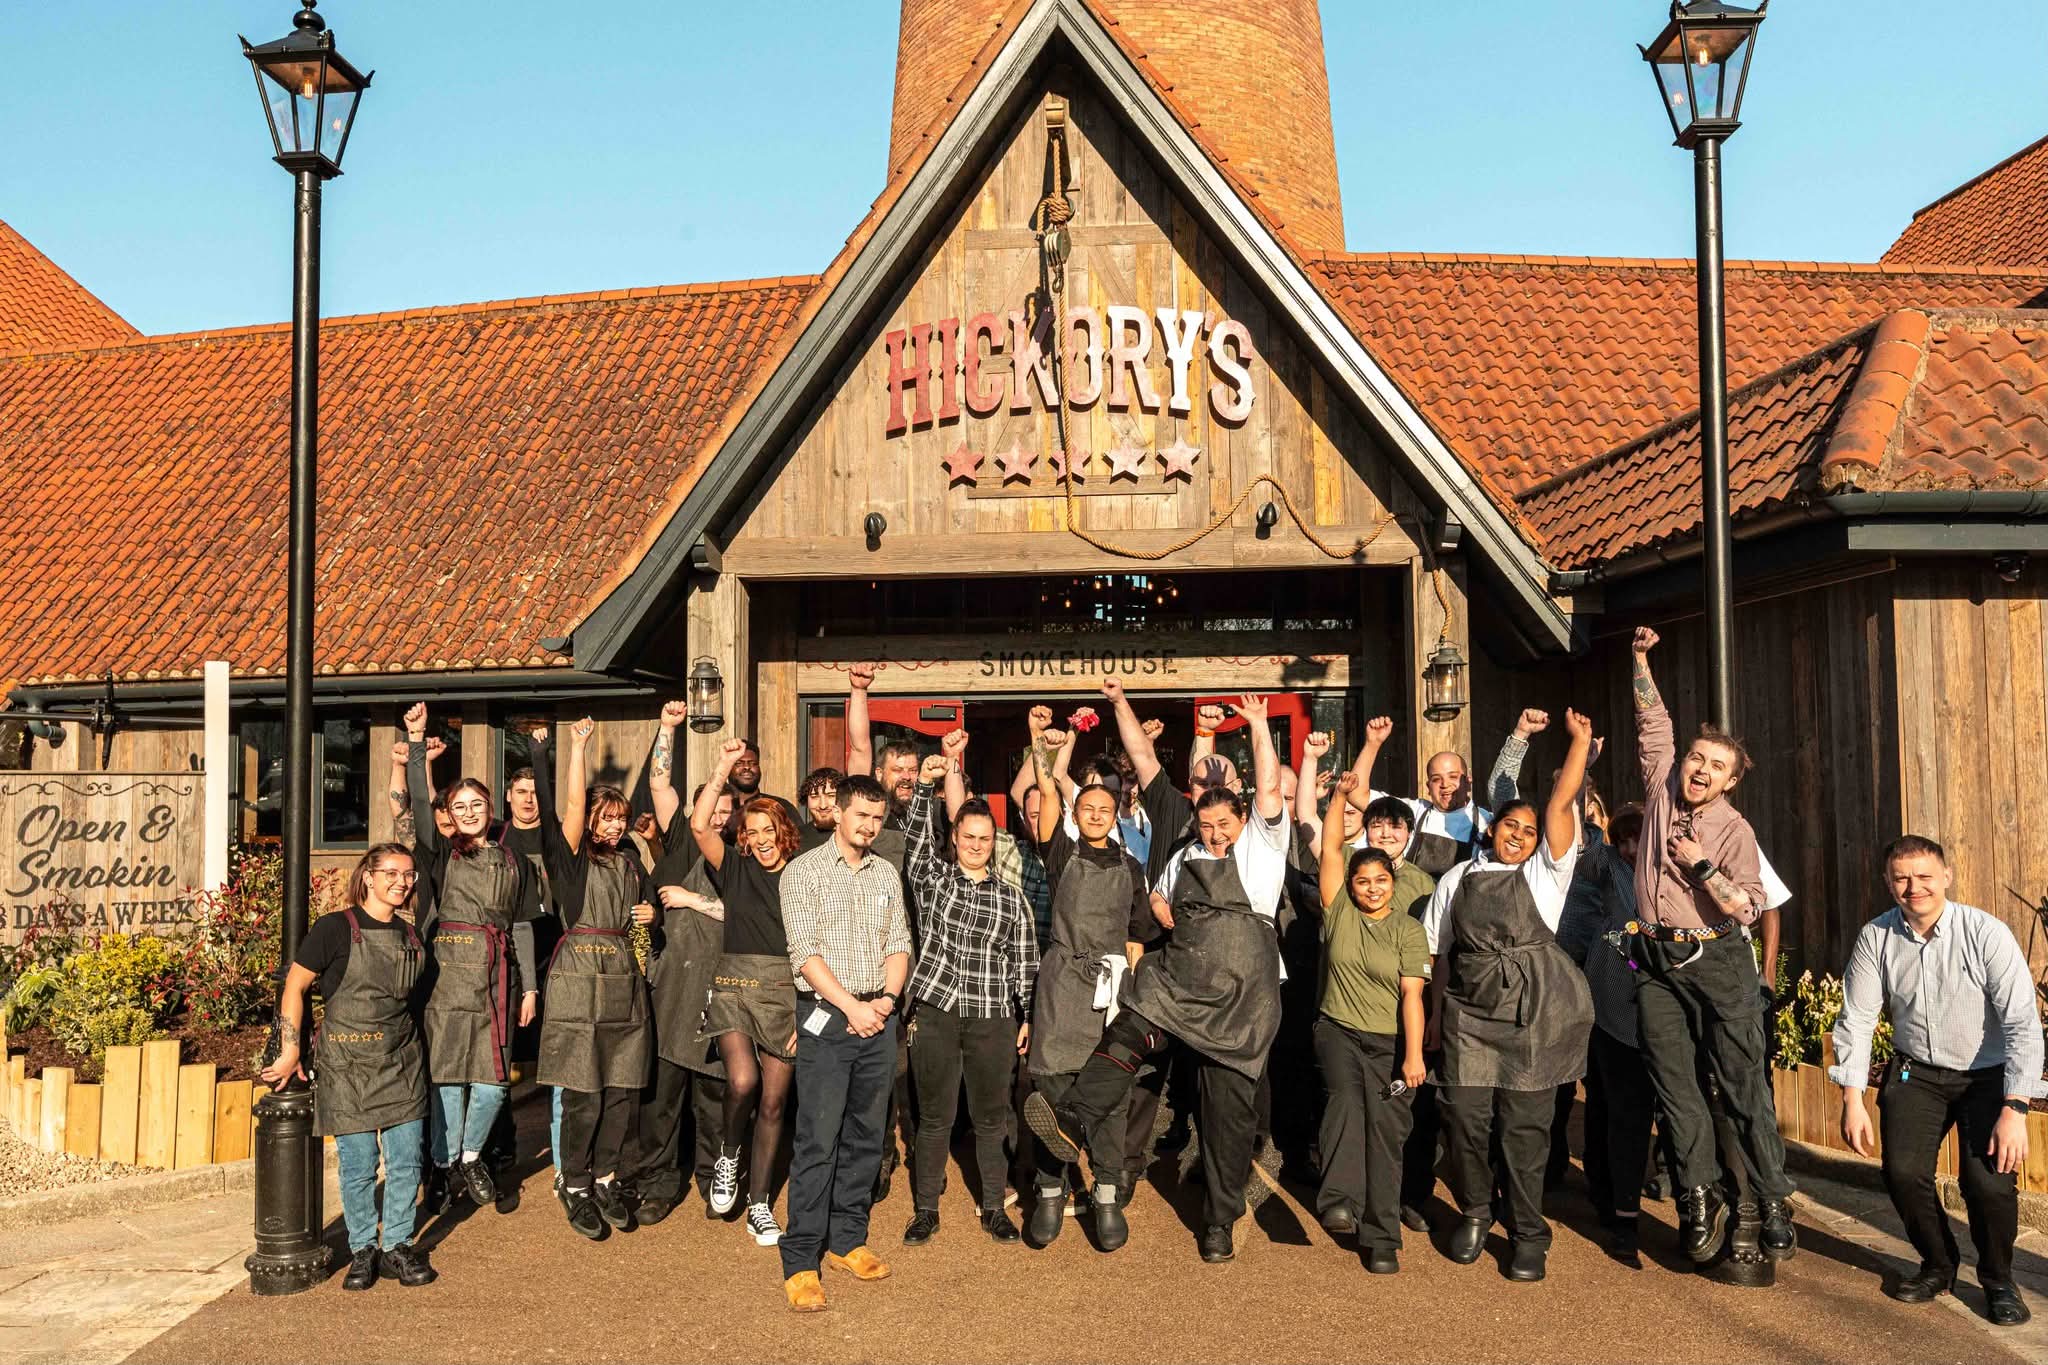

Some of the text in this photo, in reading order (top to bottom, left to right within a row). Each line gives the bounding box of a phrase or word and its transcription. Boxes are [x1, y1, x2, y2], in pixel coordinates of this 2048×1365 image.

[885, 304, 1257, 441] HICKORY'S
[978, 649, 1178, 677] SMOKEHOUSE
[17, 804, 176, 852] Open &
[5, 850, 176, 897] Smokin
[91, 902, 109, 927] A
[111, 900, 195, 926] WEEK
